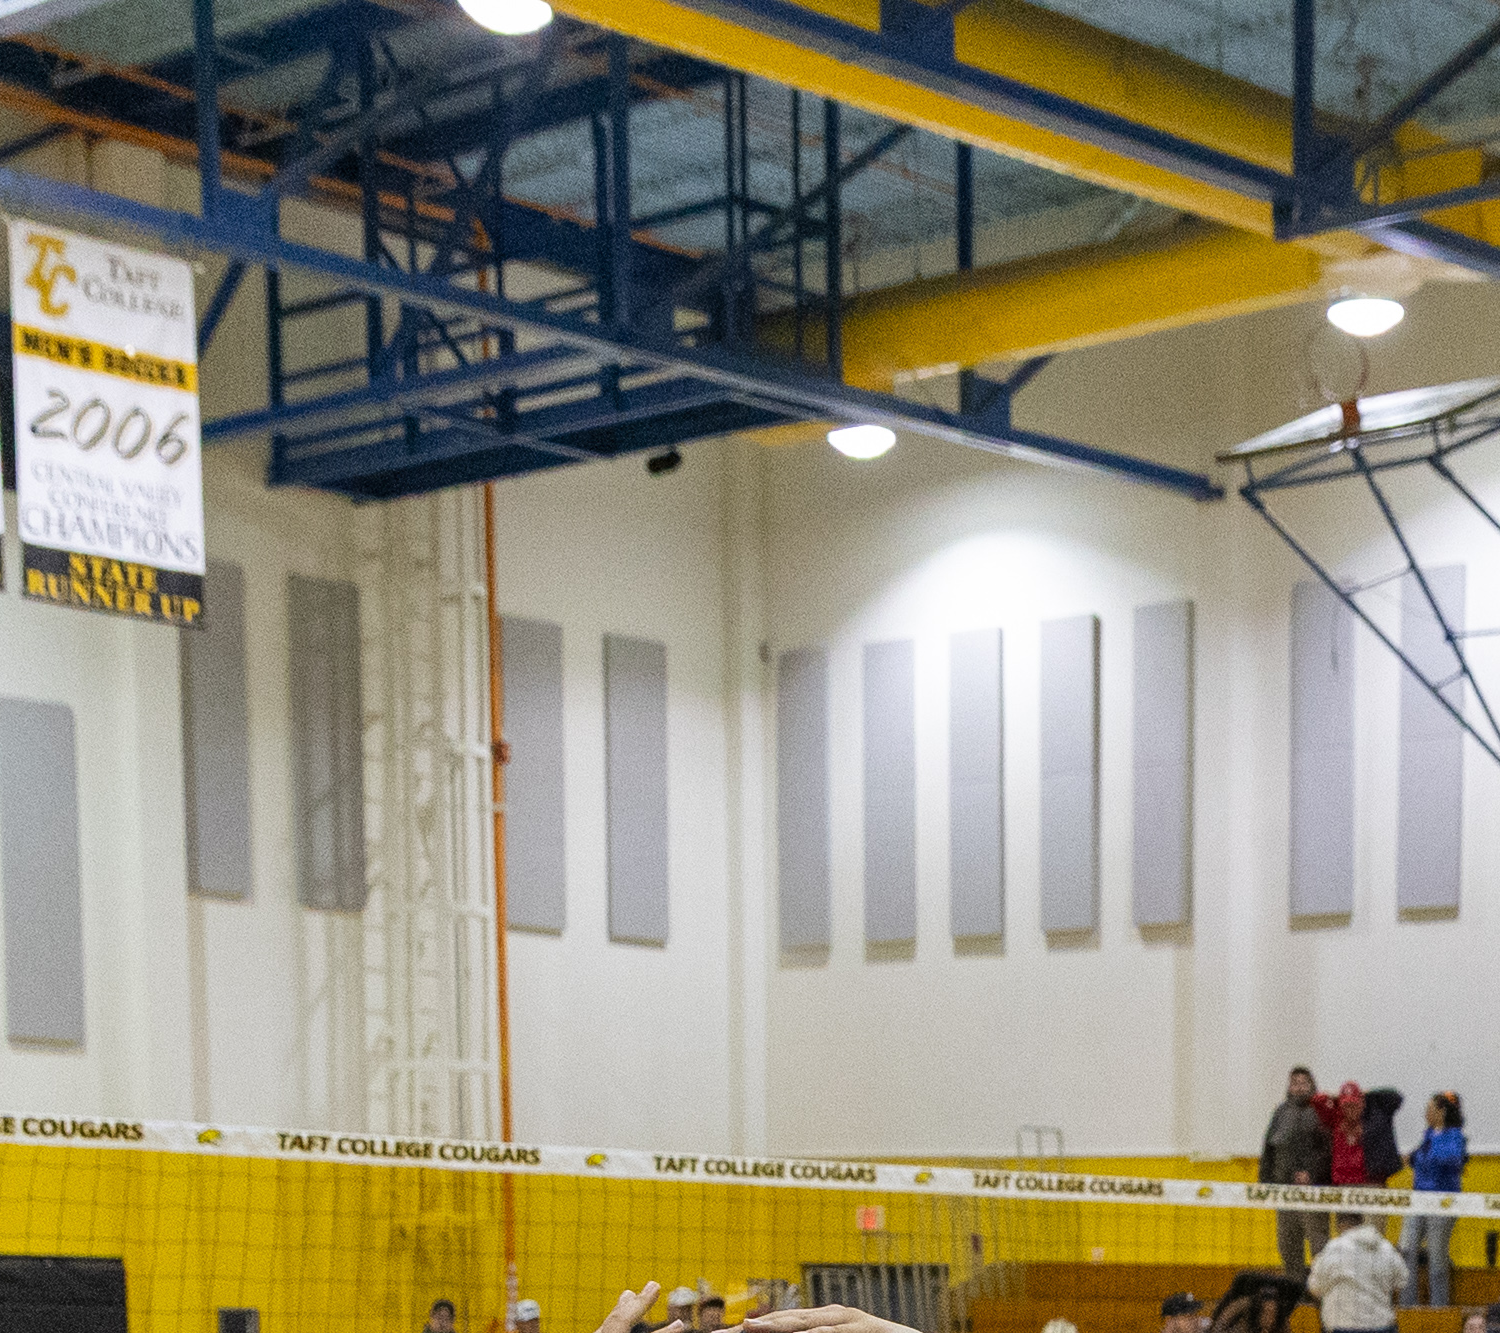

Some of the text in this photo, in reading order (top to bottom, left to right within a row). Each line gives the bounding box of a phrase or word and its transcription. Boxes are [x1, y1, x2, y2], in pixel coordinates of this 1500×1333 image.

[30, 389, 188, 467] 2006
[160, 593, 200, 622] UP
[23, 1117, 144, 1141] COUGARS
[277, 1133, 540, 1165] TAFT COLLEGE COUGARS
[654, 1155, 876, 1183] TAFT COLLEGE COUGARS
[972, 1172, 1163, 1197] TAFT COLLEGE COUGARS
